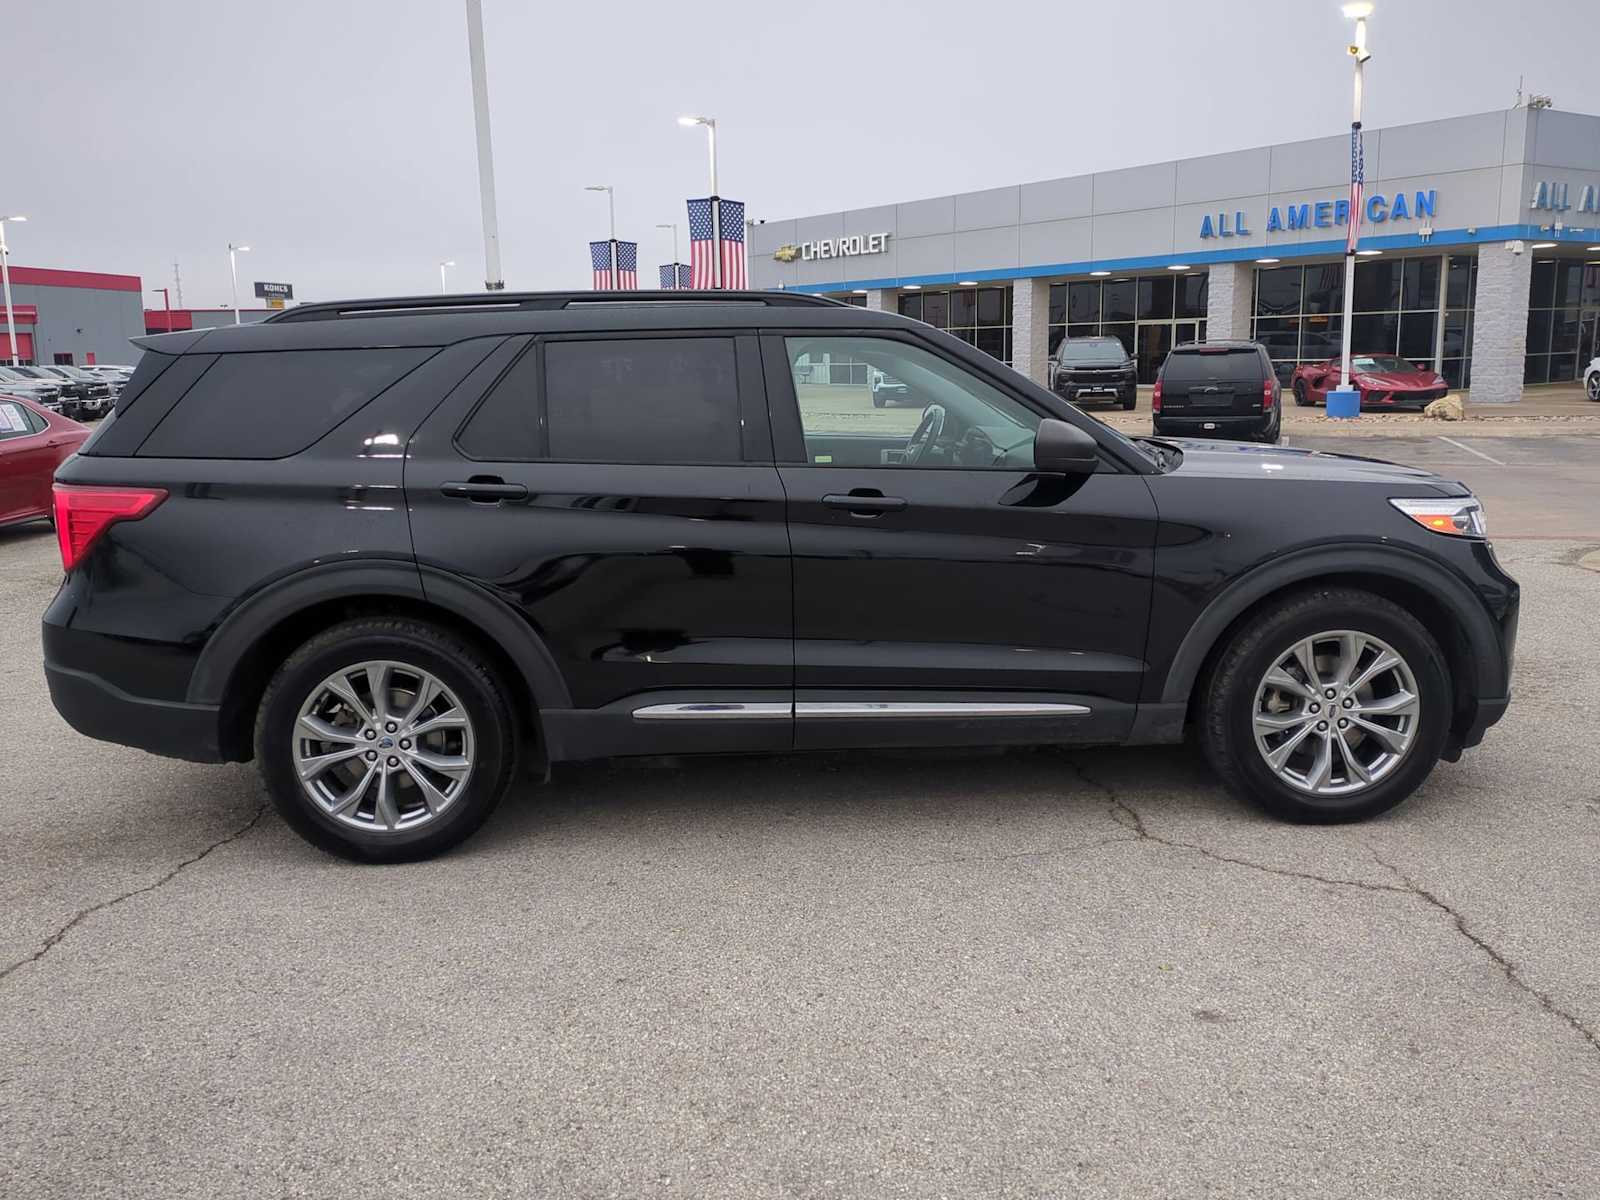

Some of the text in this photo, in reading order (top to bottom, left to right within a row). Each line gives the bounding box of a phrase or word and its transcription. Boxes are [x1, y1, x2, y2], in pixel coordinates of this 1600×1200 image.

[1531, 182, 1570, 210] ALL
[1200, 189, 1437, 240] ALL AMERCAN
[802, 233, 889, 261] CHEVROLET
